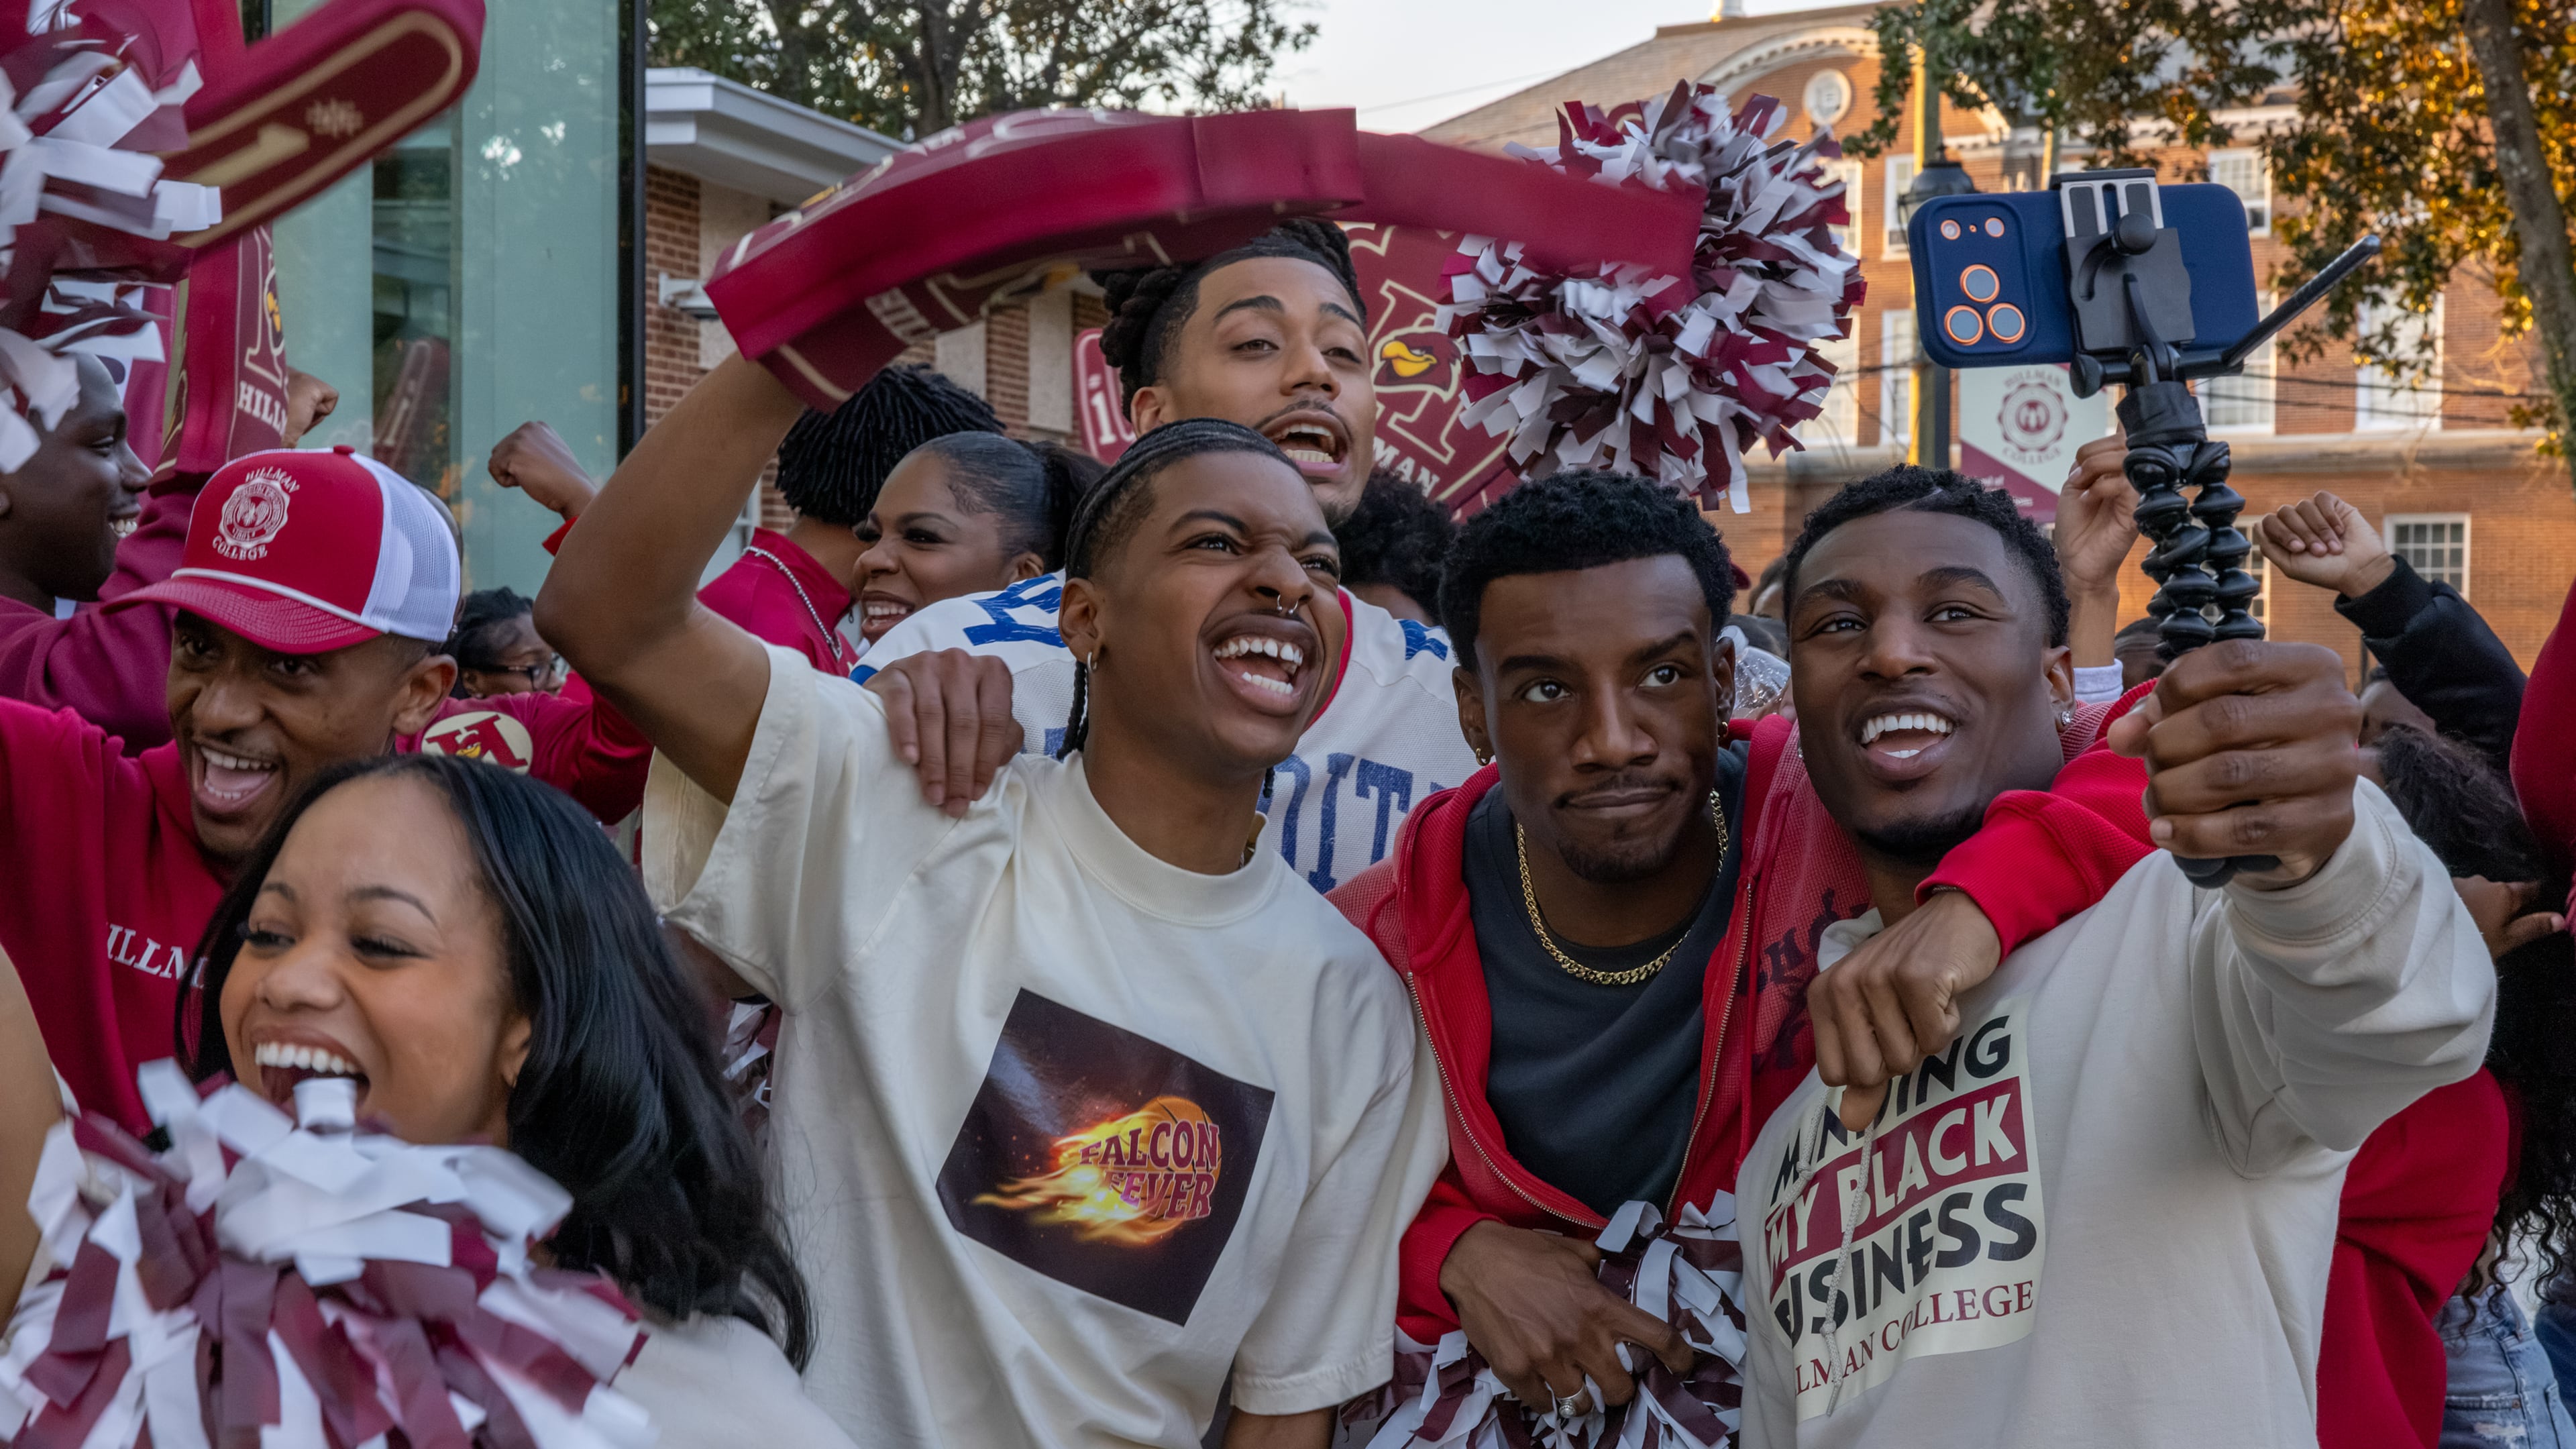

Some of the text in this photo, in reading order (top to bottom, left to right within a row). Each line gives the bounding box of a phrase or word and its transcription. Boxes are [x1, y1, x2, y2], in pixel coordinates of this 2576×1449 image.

[246, 466, 300, 493] HILLMAN
[212, 535, 268, 561] COLLEGE
[1770, 1015, 2012, 1208] MNING
[1079, 1118, 1220, 1170] FALCON
[1104, 1170, 1216, 1220] FEVER
[1769, 1093, 2019, 1268] MY BLACK
[1795, 1280, 2034, 1396] LMAN COLLEGE
